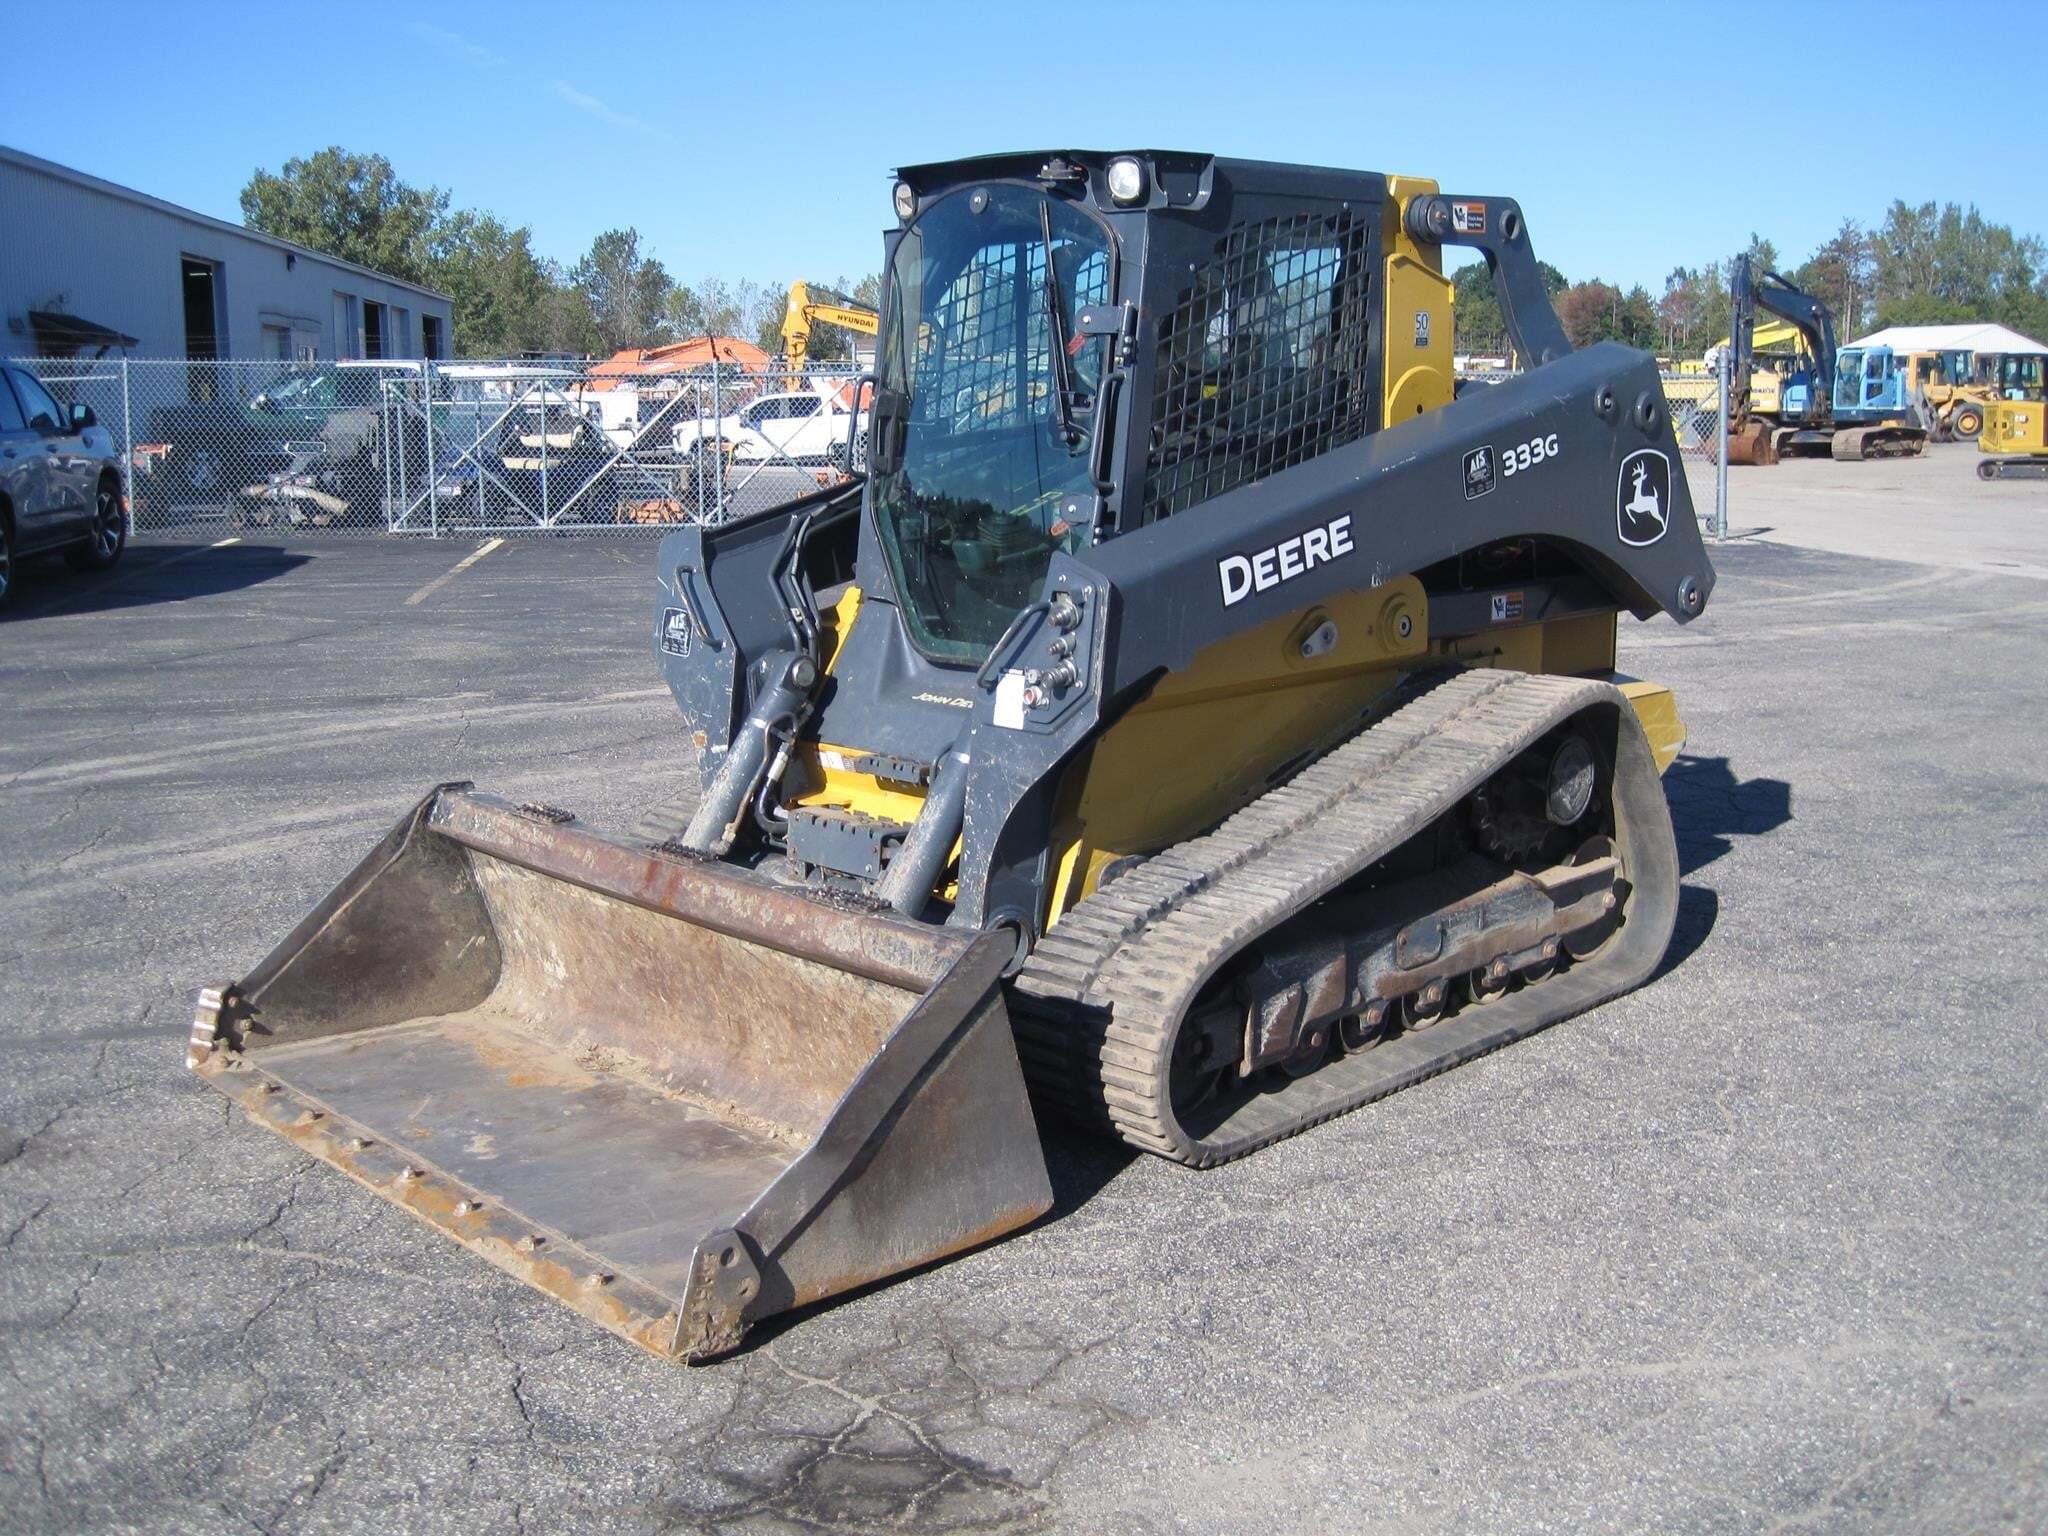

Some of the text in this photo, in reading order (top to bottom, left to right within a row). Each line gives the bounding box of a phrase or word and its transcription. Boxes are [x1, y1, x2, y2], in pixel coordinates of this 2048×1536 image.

[837, 314, 874, 328] HYUNDAI
[1415, 313, 1429, 330] 50
[1502, 433, 1559, 477] 333G
[1219, 515, 1354, 607] DEERE
[911, 692, 951, 704] JOHN
